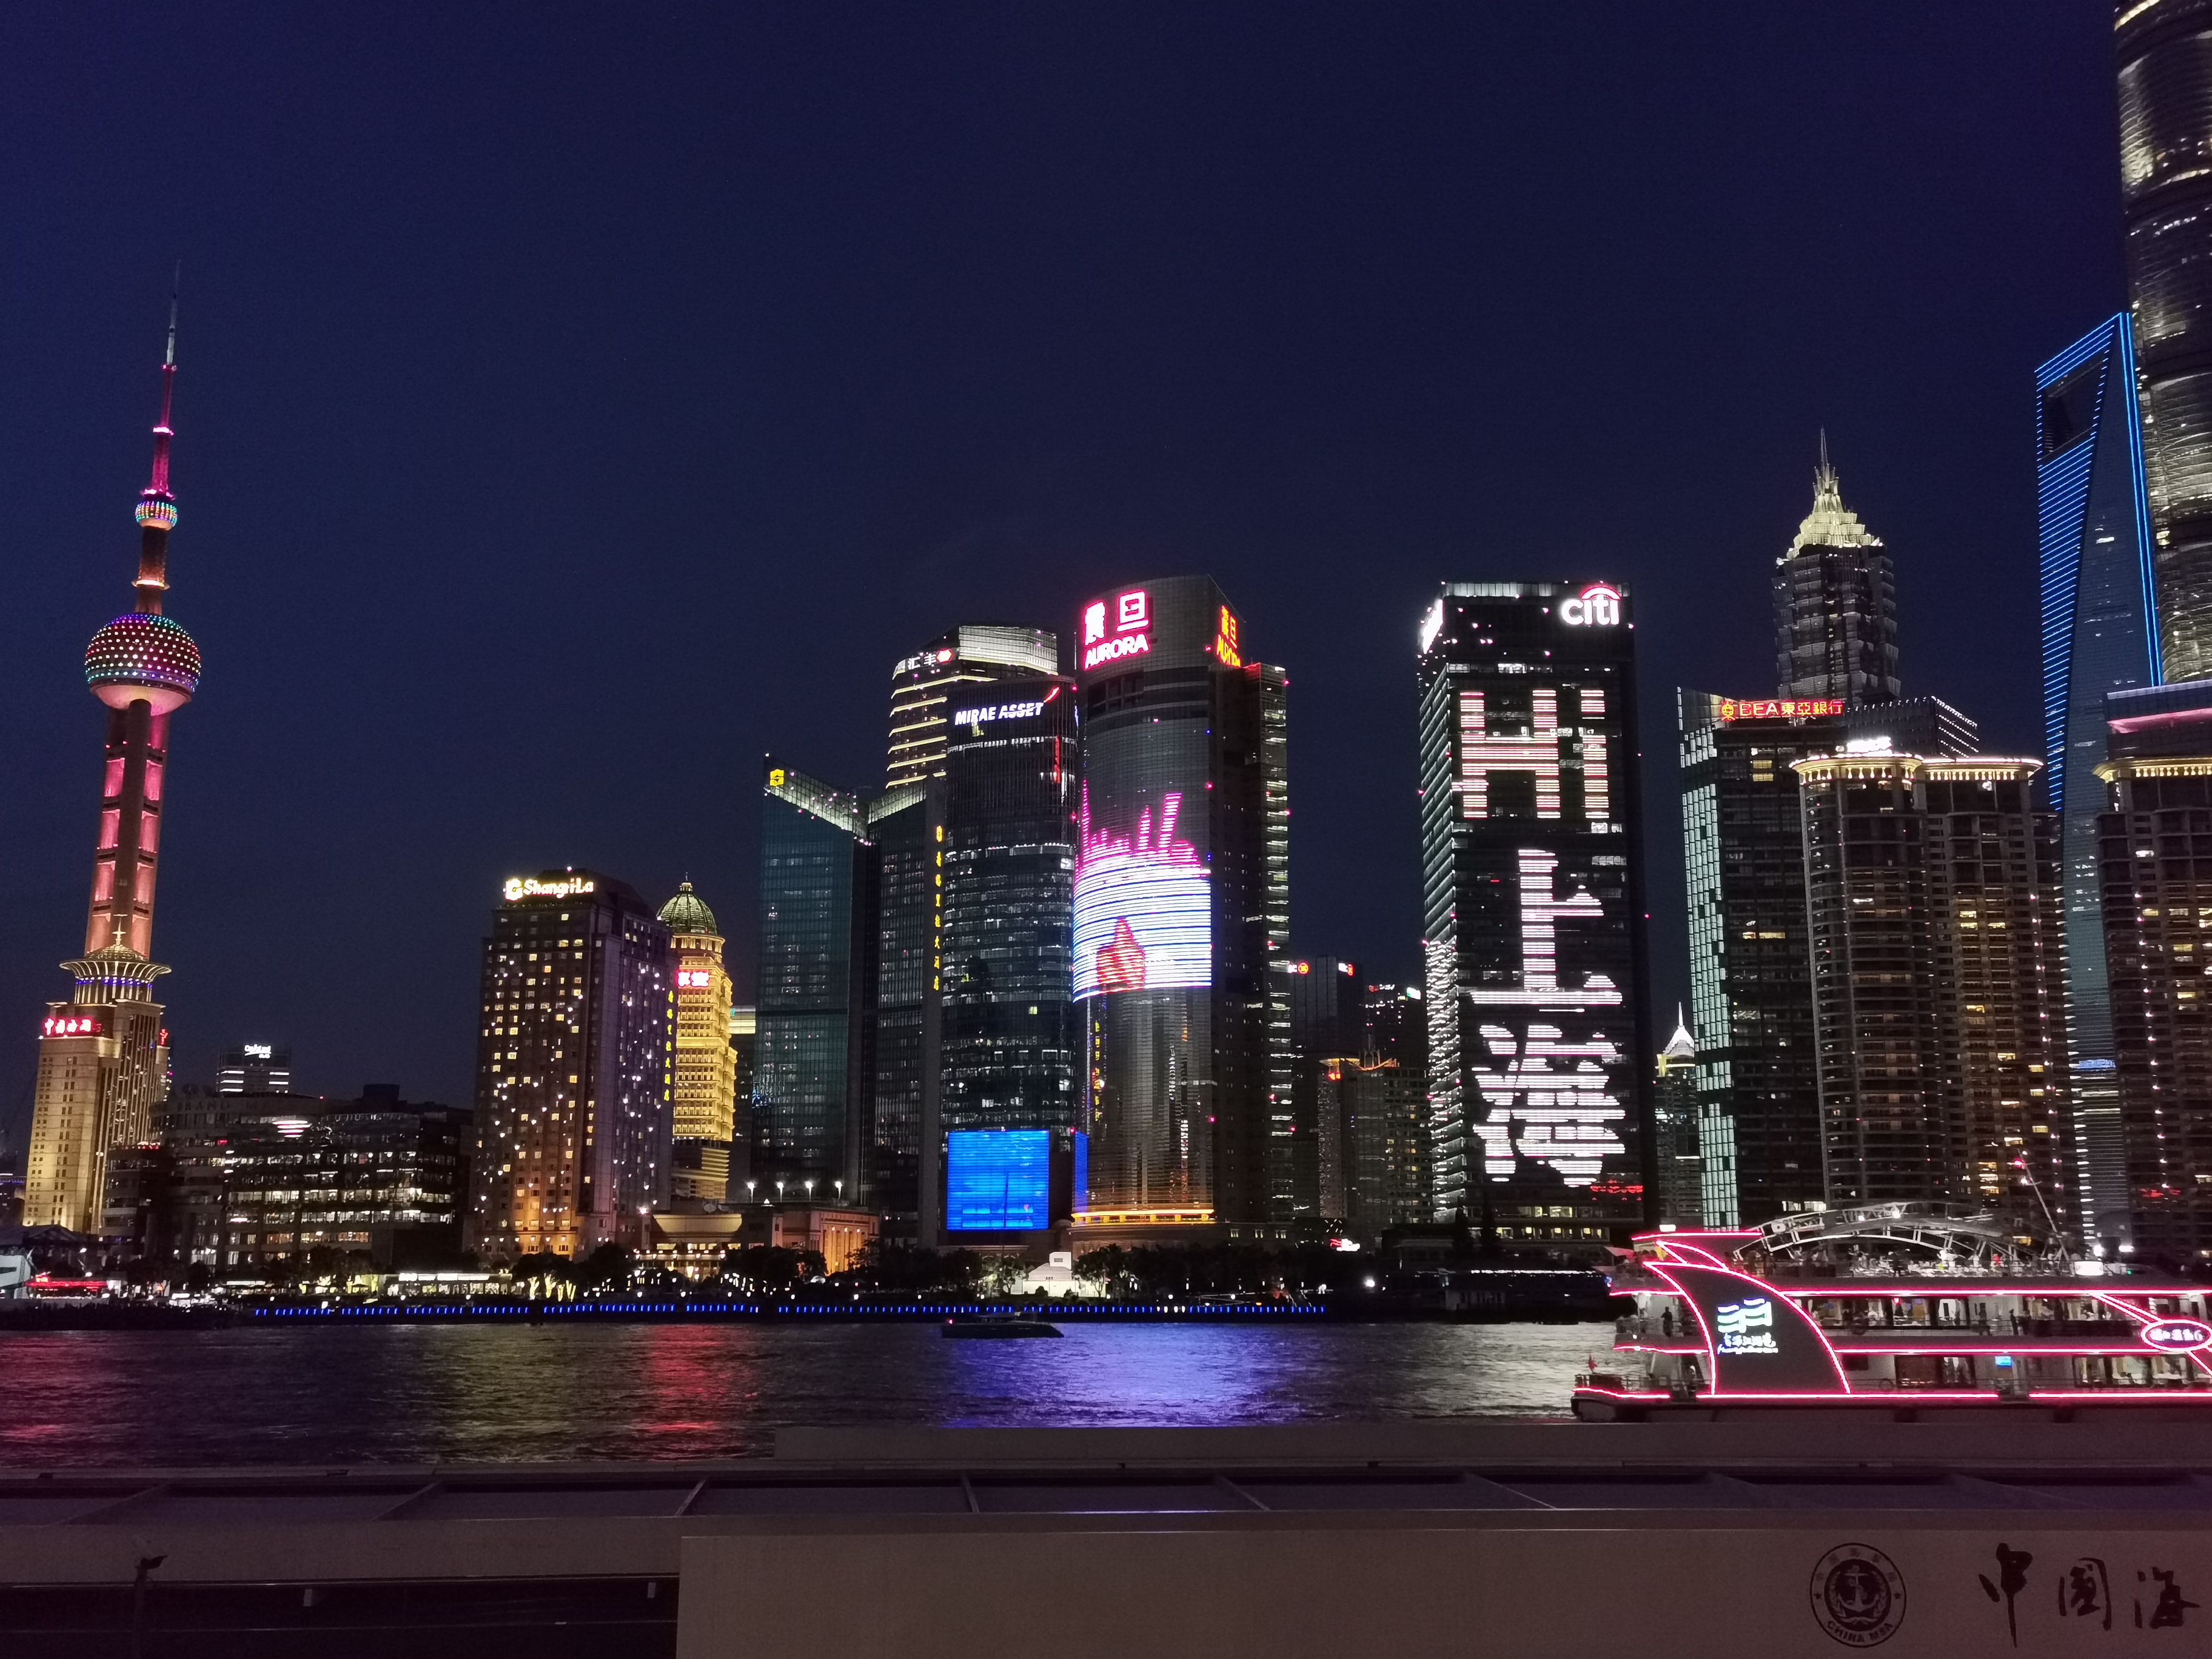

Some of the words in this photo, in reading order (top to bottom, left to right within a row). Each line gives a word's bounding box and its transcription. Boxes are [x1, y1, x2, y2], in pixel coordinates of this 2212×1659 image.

[1561, 588, 1621, 625] citi
[907, 653, 937, 671] 汇丰
[1084, 633, 1149, 669] AURORA
[954, 706, 997, 726] MIRAE
[998, 702, 1044, 720] ASSET
[1739, 702, 1779, 717] BEA
[1780, 700, 1843, 716] 東亞銀行
[1460, 690, 1610, 819] Hi
[1470, 849, 1626, 1188] 上海
[1827, 1620, 1865, 1643] CHINA
